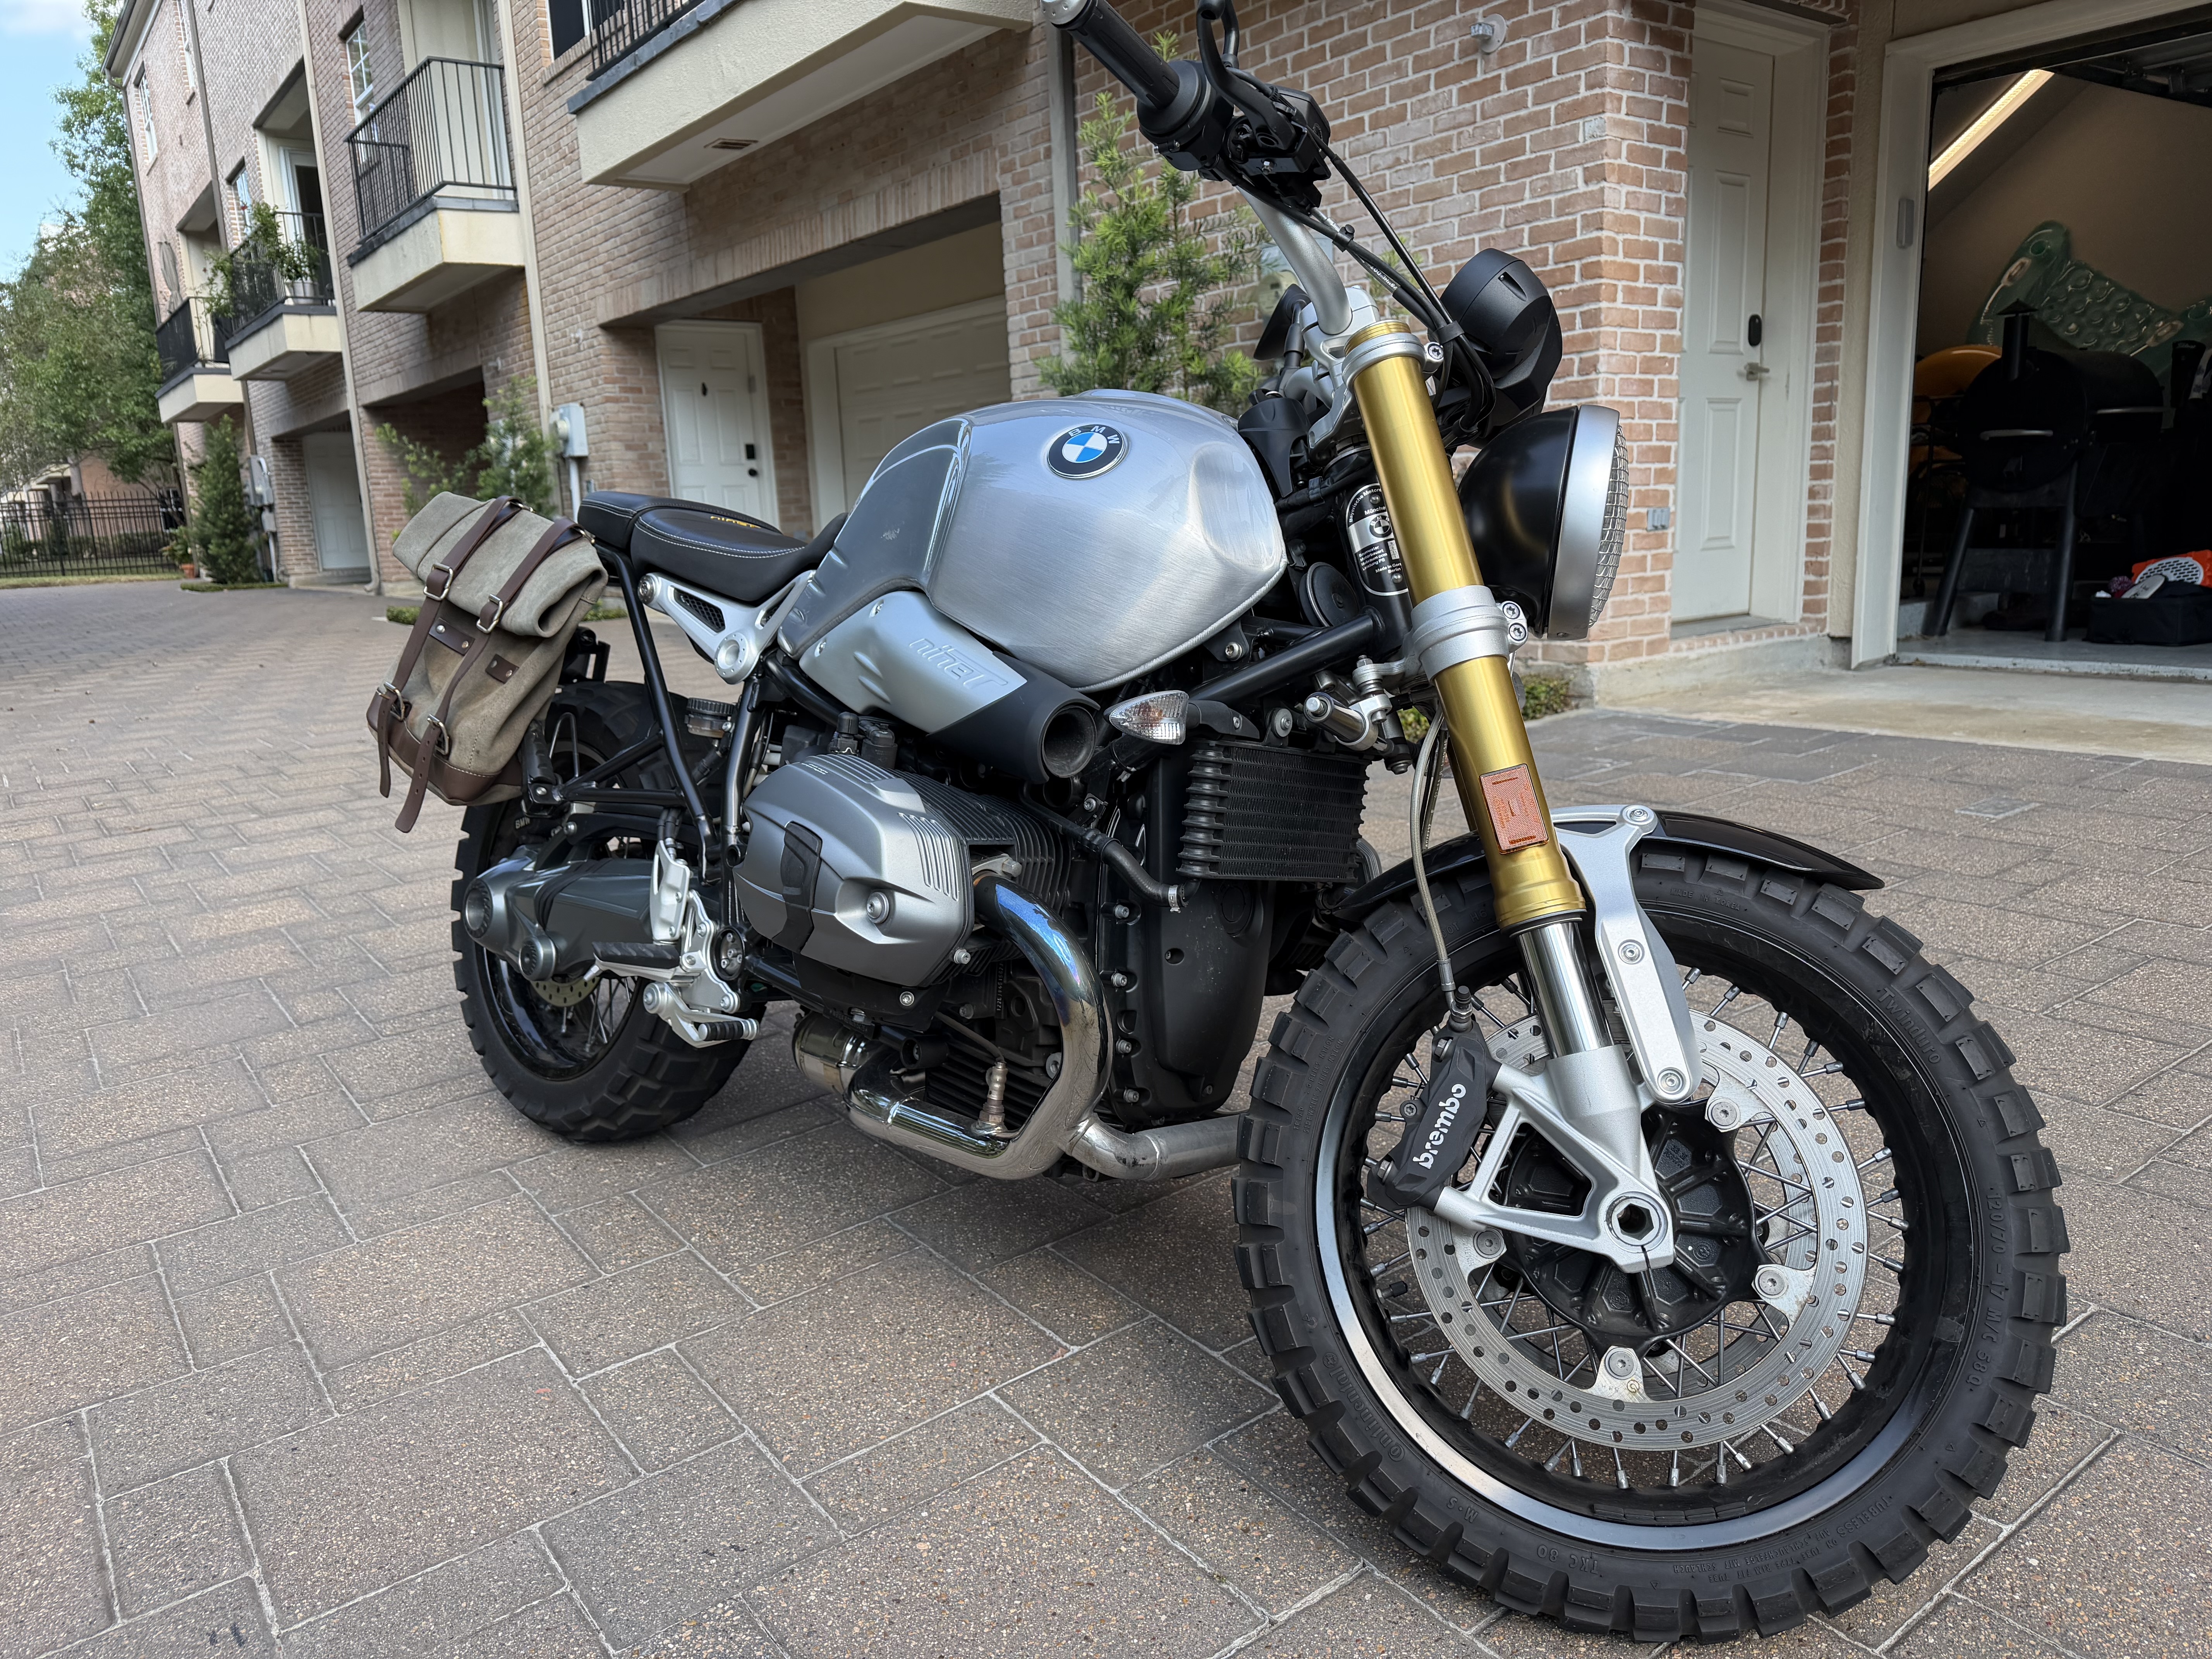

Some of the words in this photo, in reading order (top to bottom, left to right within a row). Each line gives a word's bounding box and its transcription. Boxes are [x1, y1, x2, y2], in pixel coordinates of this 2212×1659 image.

[1069, 426, 1120, 444] BMW
[515, 817, 530, 829] BMW
[1876, 988, 1941, 1064] Twinduro
[1412, 1083, 1466, 1170] brembo
[1966, 1350, 1991, 1386] 58Q
[1836, 1497, 1891, 1537] TUBELESS
[1537, 1545, 1559, 1562] 80
[1569, 1554, 1599, 1574] TKC
